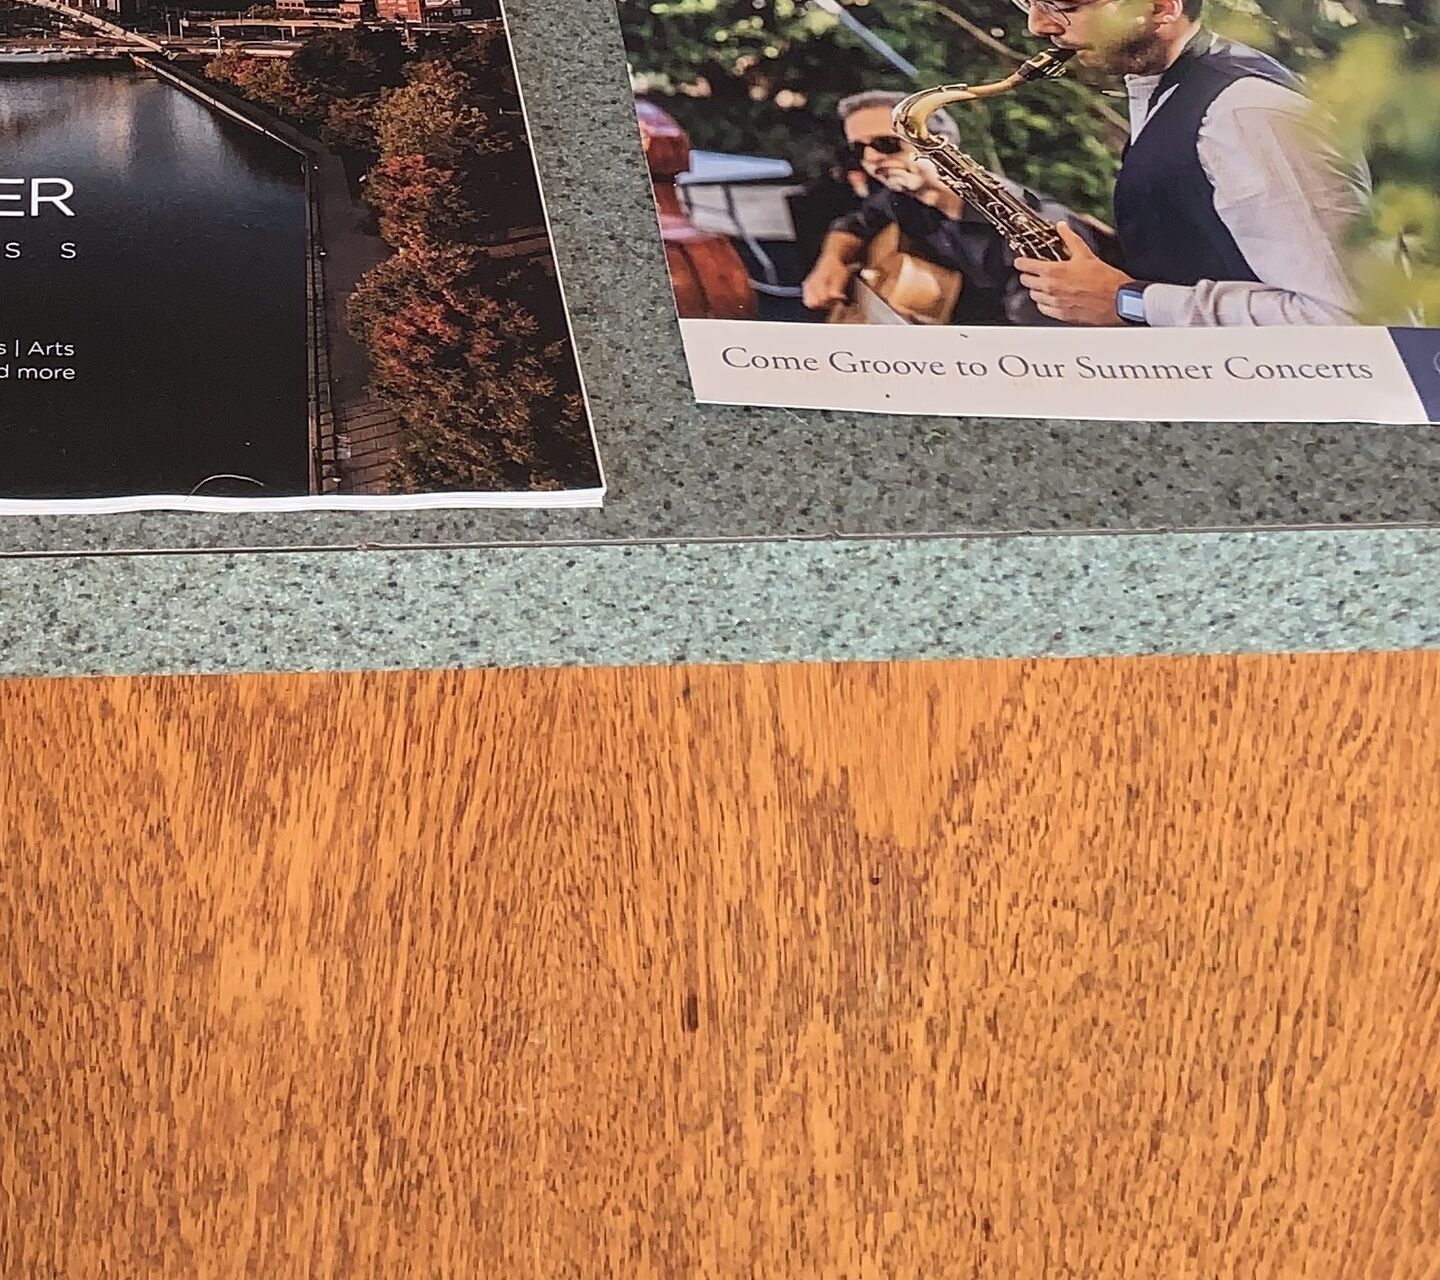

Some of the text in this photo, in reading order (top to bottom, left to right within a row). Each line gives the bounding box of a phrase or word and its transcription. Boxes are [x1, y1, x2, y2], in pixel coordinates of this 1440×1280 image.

[27, 340, 75, 357] Arts
[722, 346, 1373, 380] Come Groove to Our Summer Concerts
[17, 366, 76, 380] more
